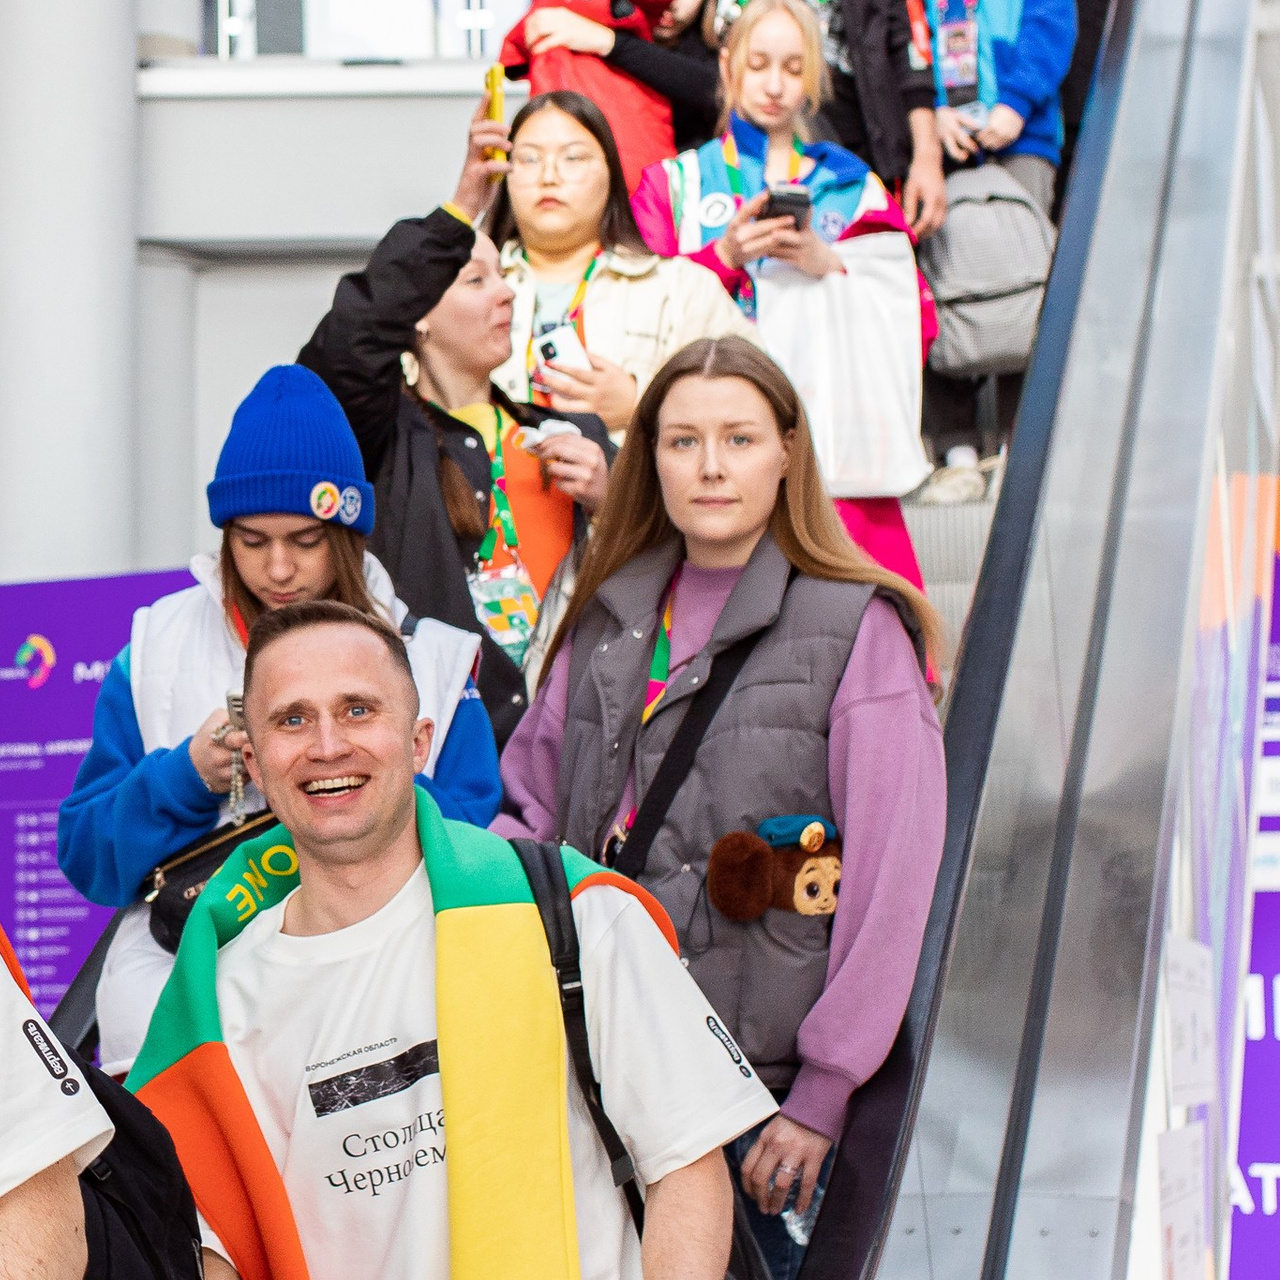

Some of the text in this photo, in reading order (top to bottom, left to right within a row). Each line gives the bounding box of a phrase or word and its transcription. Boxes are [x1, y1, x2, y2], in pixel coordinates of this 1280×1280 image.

[26, 1023, 66, 1079] вертикаль
[305, 1037, 398, 1072] ВОРОНЕЖСКАЯ ОБЛАСТЬ
[325, 1144, 447, 1197] Черноем
